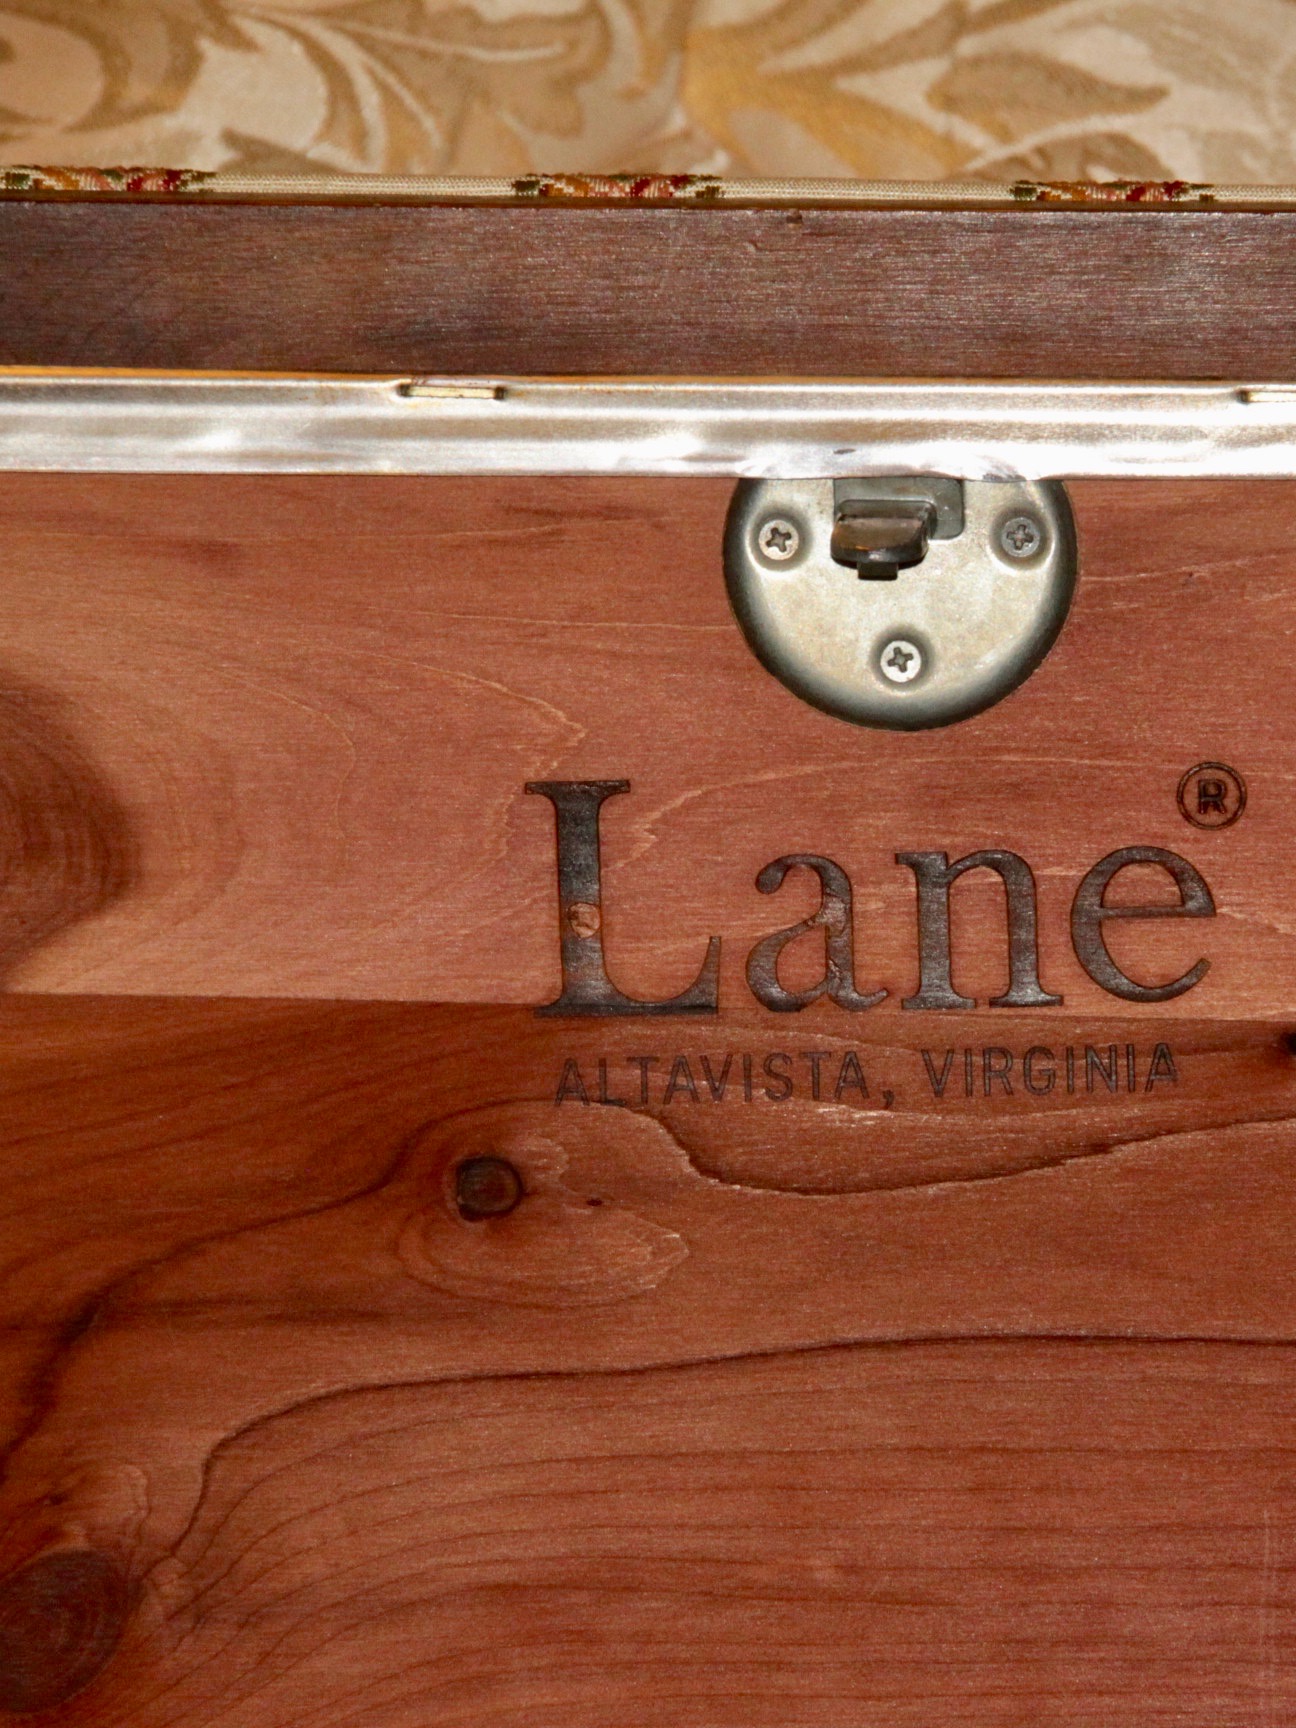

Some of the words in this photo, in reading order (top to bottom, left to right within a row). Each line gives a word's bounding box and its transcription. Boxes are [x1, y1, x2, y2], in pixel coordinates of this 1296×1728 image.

[524, 779, 1217, 1015] Lane
[555, 1050, 896, 1108] ALTAVISTA,
[920, 1042, 1179, 1099] VIRGINIA
